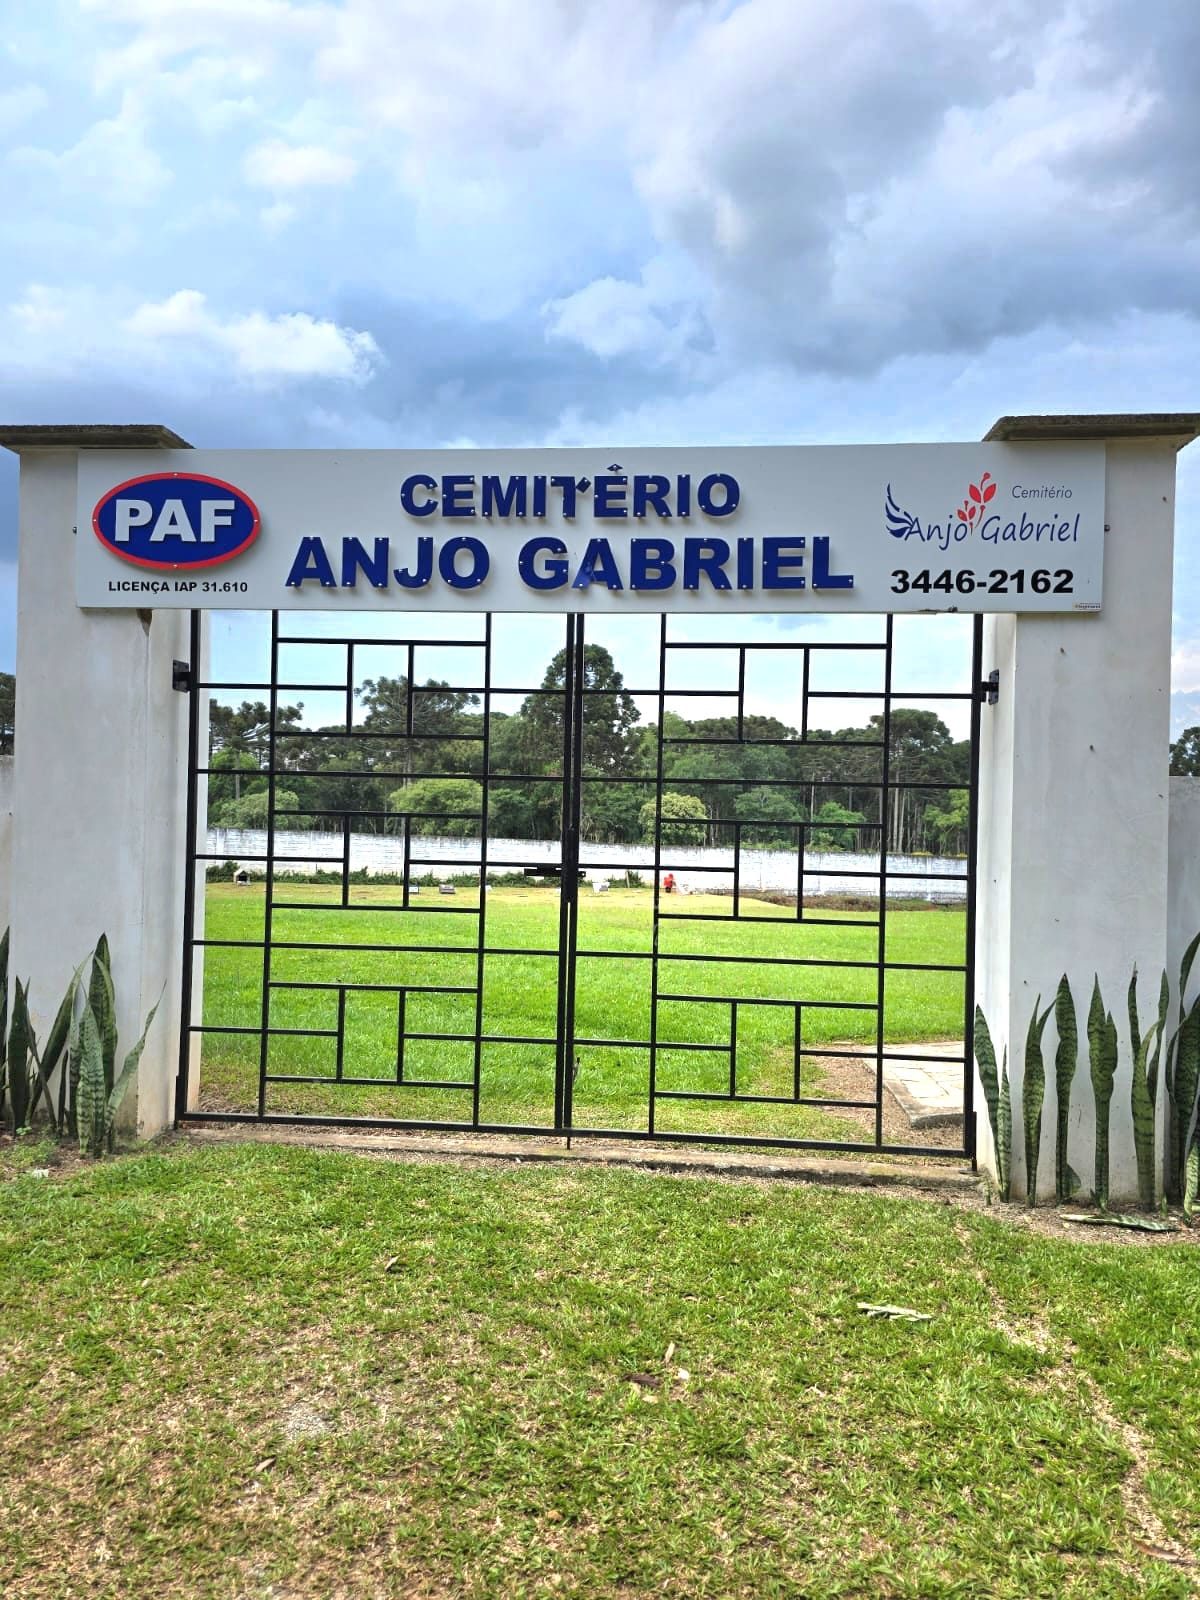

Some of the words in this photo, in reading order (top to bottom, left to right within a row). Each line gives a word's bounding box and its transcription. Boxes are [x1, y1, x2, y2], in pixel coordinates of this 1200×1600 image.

[1011, 484, 1073, 500] Cemitério
[114, 499, 236, 542] PAF
[903, 514, 968, 550] Anjo
[981, 512, 1080, 544] Gabriel
[285, 536, 490, 590] ANJO
[518, 536, 854, 592] GABRIEL
[108, 581, 169, 595] LICENÇA
[174, 582, 198, 593] IAP
[202, 582, 248, 593] 31.610
[890, 569, 1074, 594] 3446-2162
